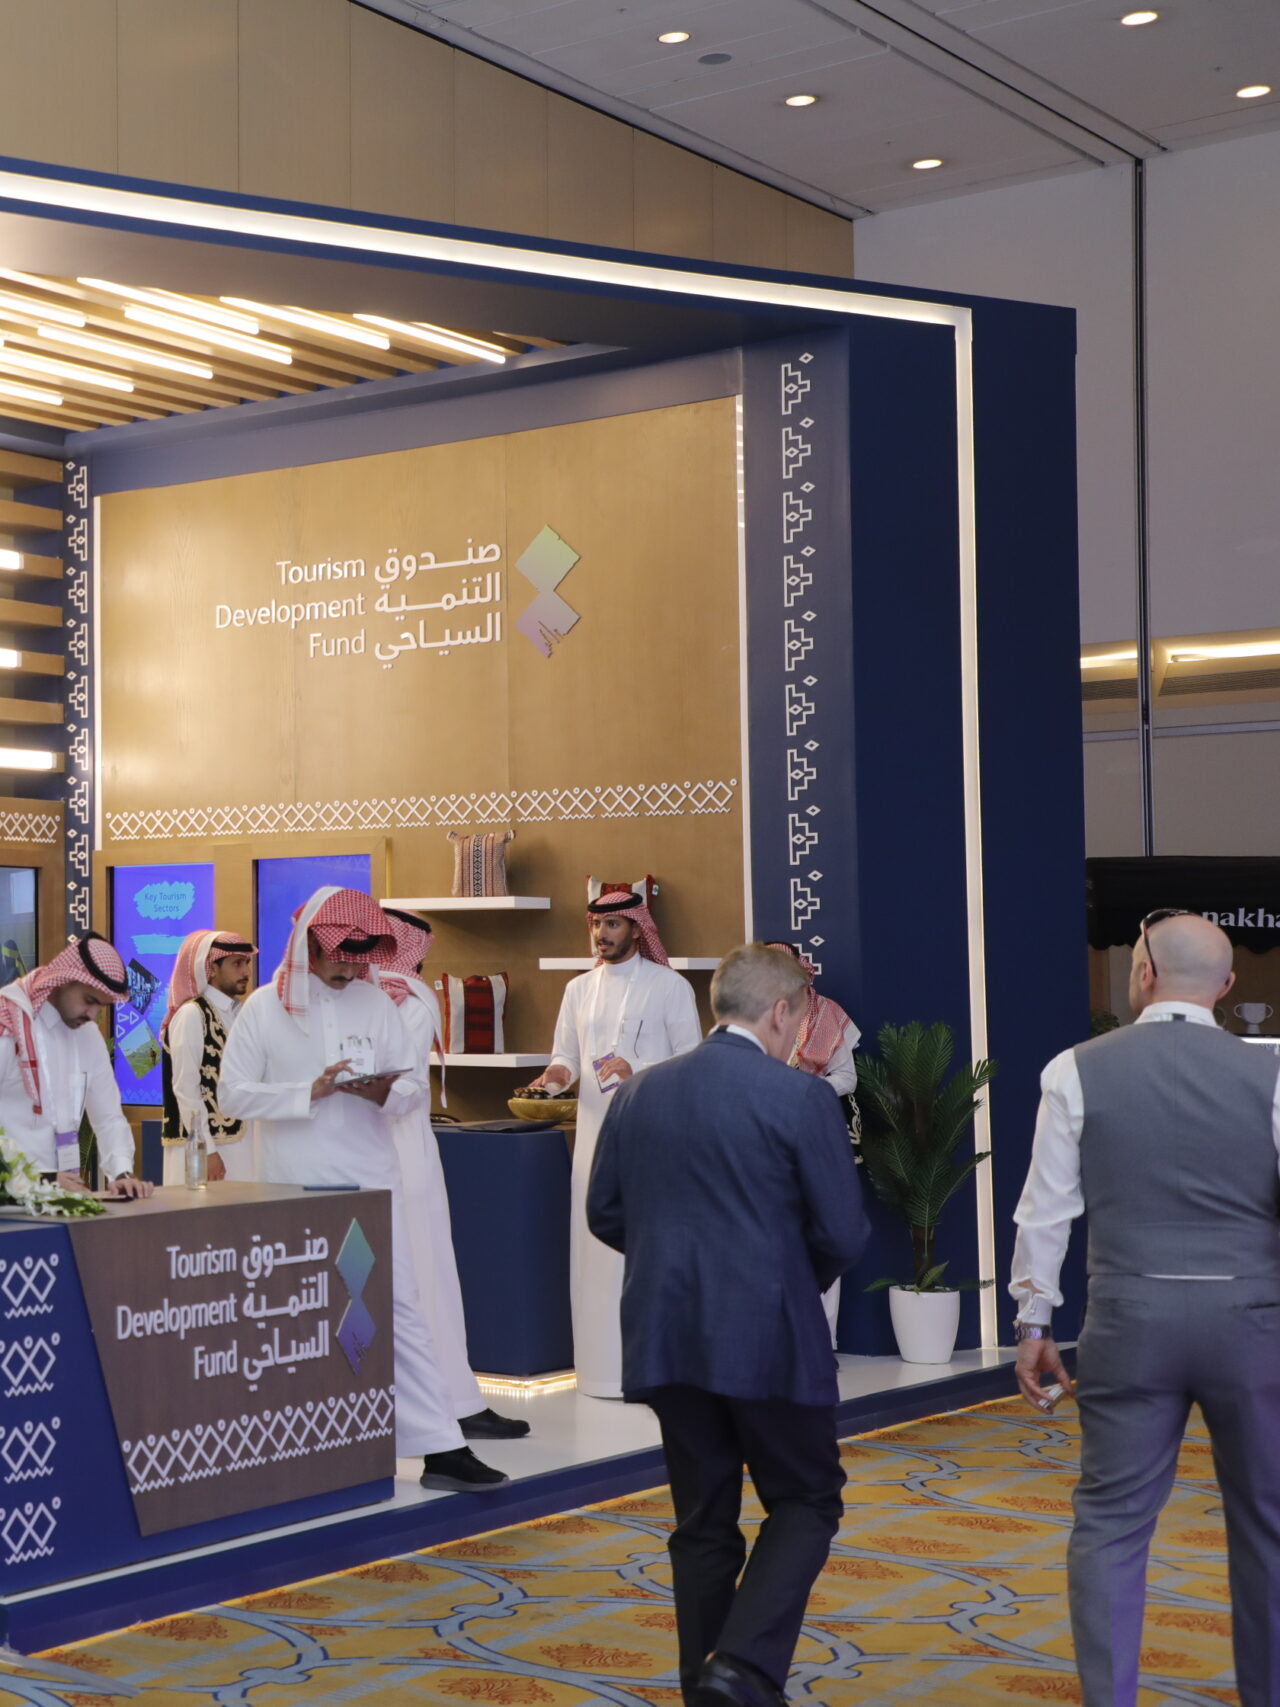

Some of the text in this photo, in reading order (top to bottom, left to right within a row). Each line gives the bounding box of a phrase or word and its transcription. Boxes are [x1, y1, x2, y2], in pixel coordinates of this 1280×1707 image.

[276, 557, 365, 585] Tourism
[374, 538, 502, 584] صندوق
[215, 592, 366, 629] Development
[374, 572, 501, 620] التنمية
[309, 629, 365, 658] Fund
[374, 612, 502, 669] السياحي
[144, 892, 187, 903] Key Tourism
[153, 904, 180, 913] Sectors
[166, 1244, 237, 1280] Tourism
[242, 1228, 329, 1281] صندوق
[116, 1293, 238, 1340] Development
[242, 1271, 329, 1328] التنمية
[193, 1339, 238, 1380] Fund
[242, 1320, 330, 1392] السياحي
